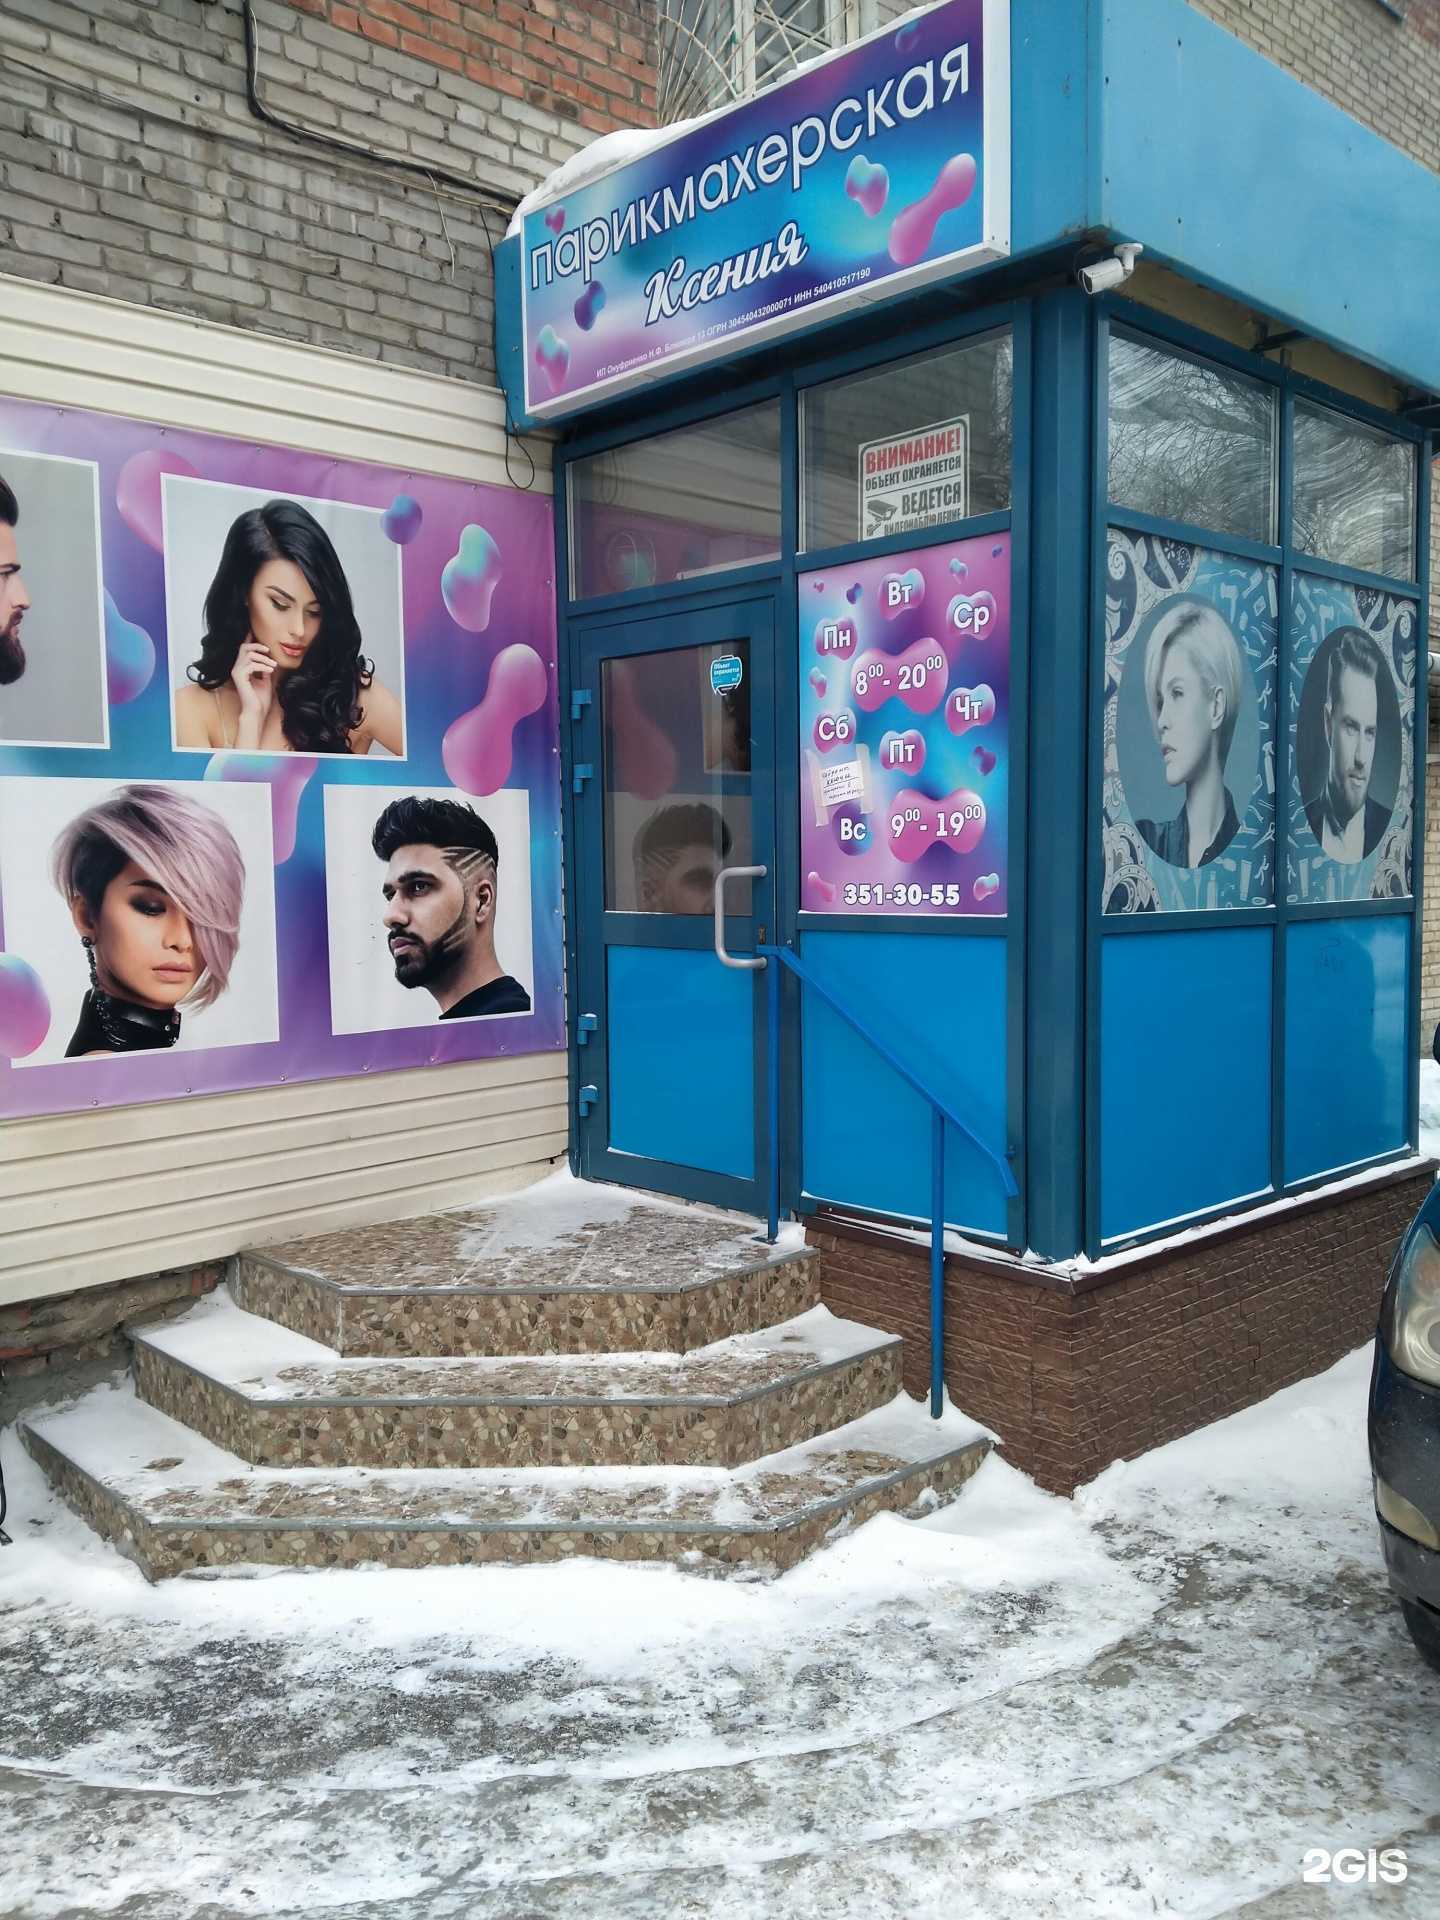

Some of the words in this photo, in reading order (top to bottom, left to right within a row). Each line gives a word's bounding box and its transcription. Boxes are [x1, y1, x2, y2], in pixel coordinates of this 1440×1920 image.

[531, 41, 970, 289] парикмахерская
[644, 222, 809, 328] Ксения
[706, 321, 728, 337] ОГРН
[794, 288, 813, 304] ИНН
[813, 267, 871, 298] 540410517190
[866, 427, 961, 475] ВНИМАНИЕ!
[865, 470, 901, 492] ОБЪЕКТ
[902, 454, 961, 483] ОХРАНЯЕТСЯ
[901, 481, 961, 516] ВЕДЕТСЯ
[887, 581, 913, 608] Вт
[952, 603, 990, 635] Ср
[823, 626, 851, 650] Пн
[955, 696, 982, 721] Чт
[818, 715, 850, 740] Сб
[888, 739, 916, 764] Пт
[839, 817, 867, 842] Вс
[843, 883, 961, 907] 351-30-55
